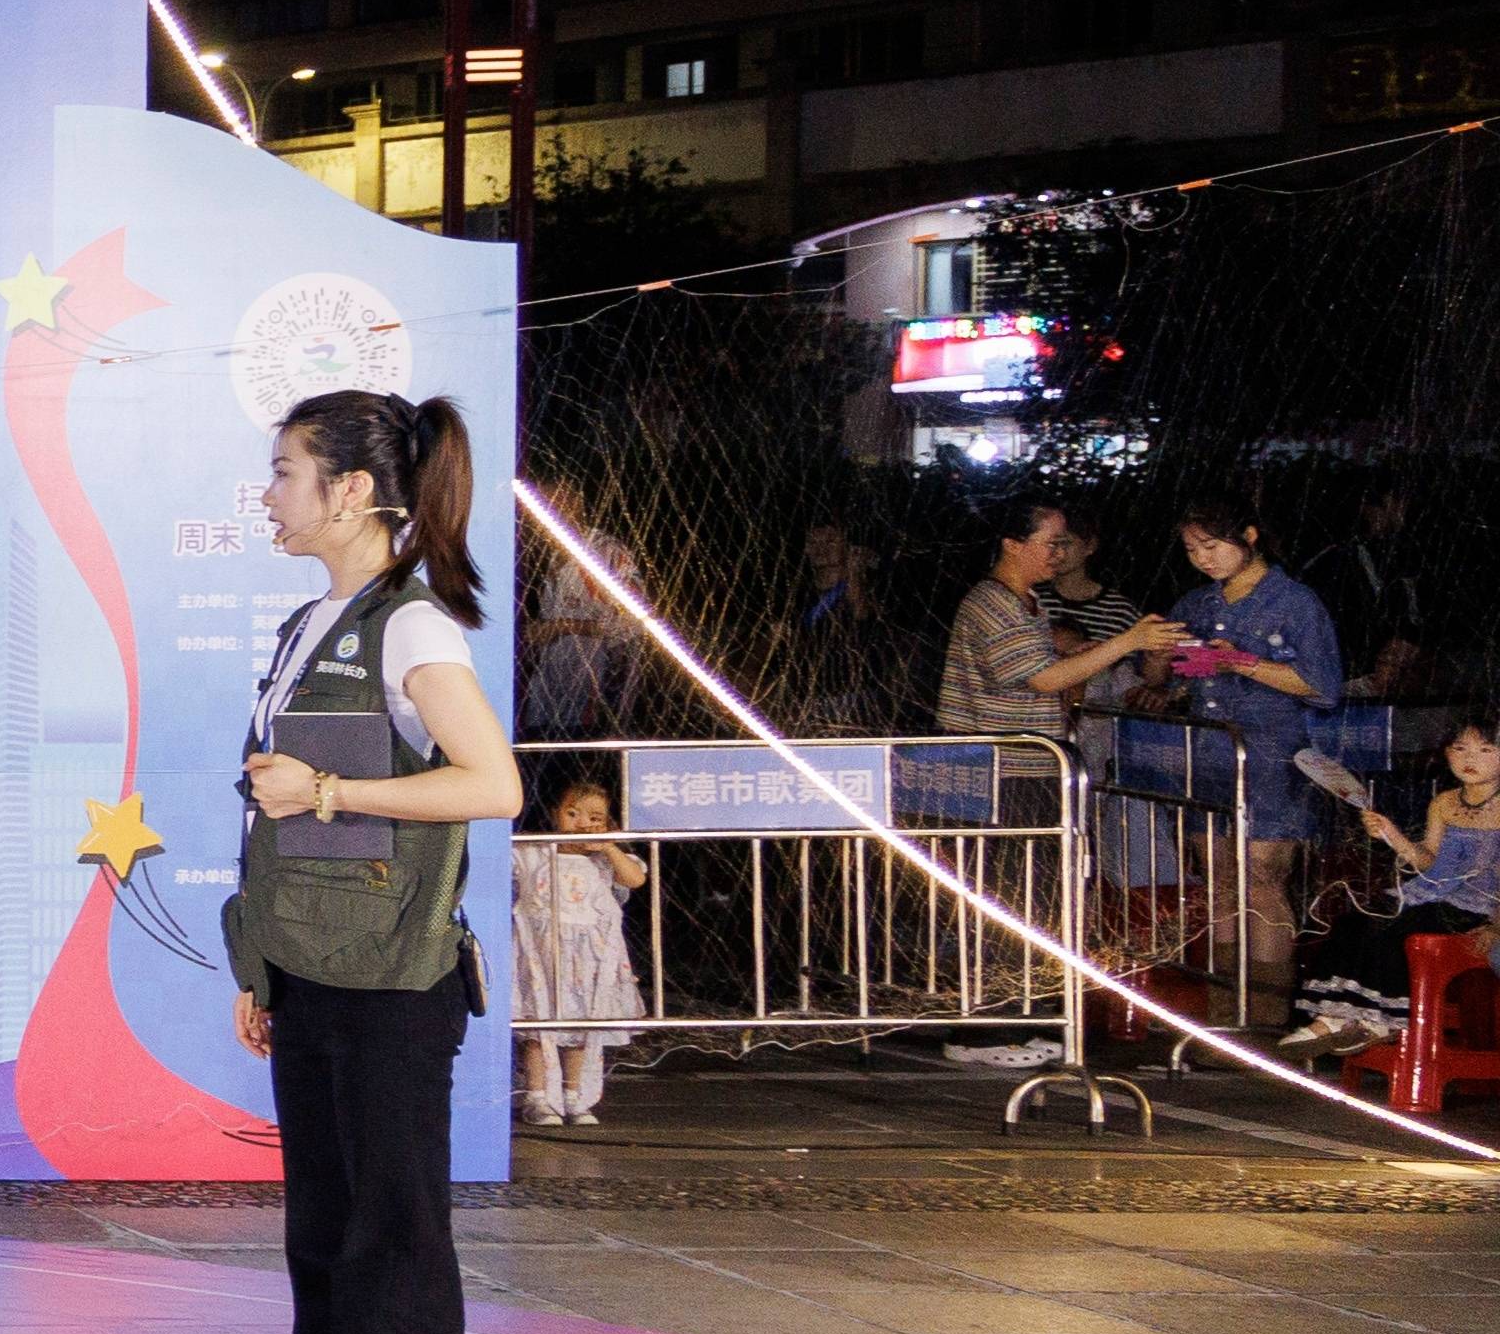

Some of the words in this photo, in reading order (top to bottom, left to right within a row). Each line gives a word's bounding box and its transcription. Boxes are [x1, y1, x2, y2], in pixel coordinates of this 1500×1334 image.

[640, 768, 875, 807] 英德市歌舞团
